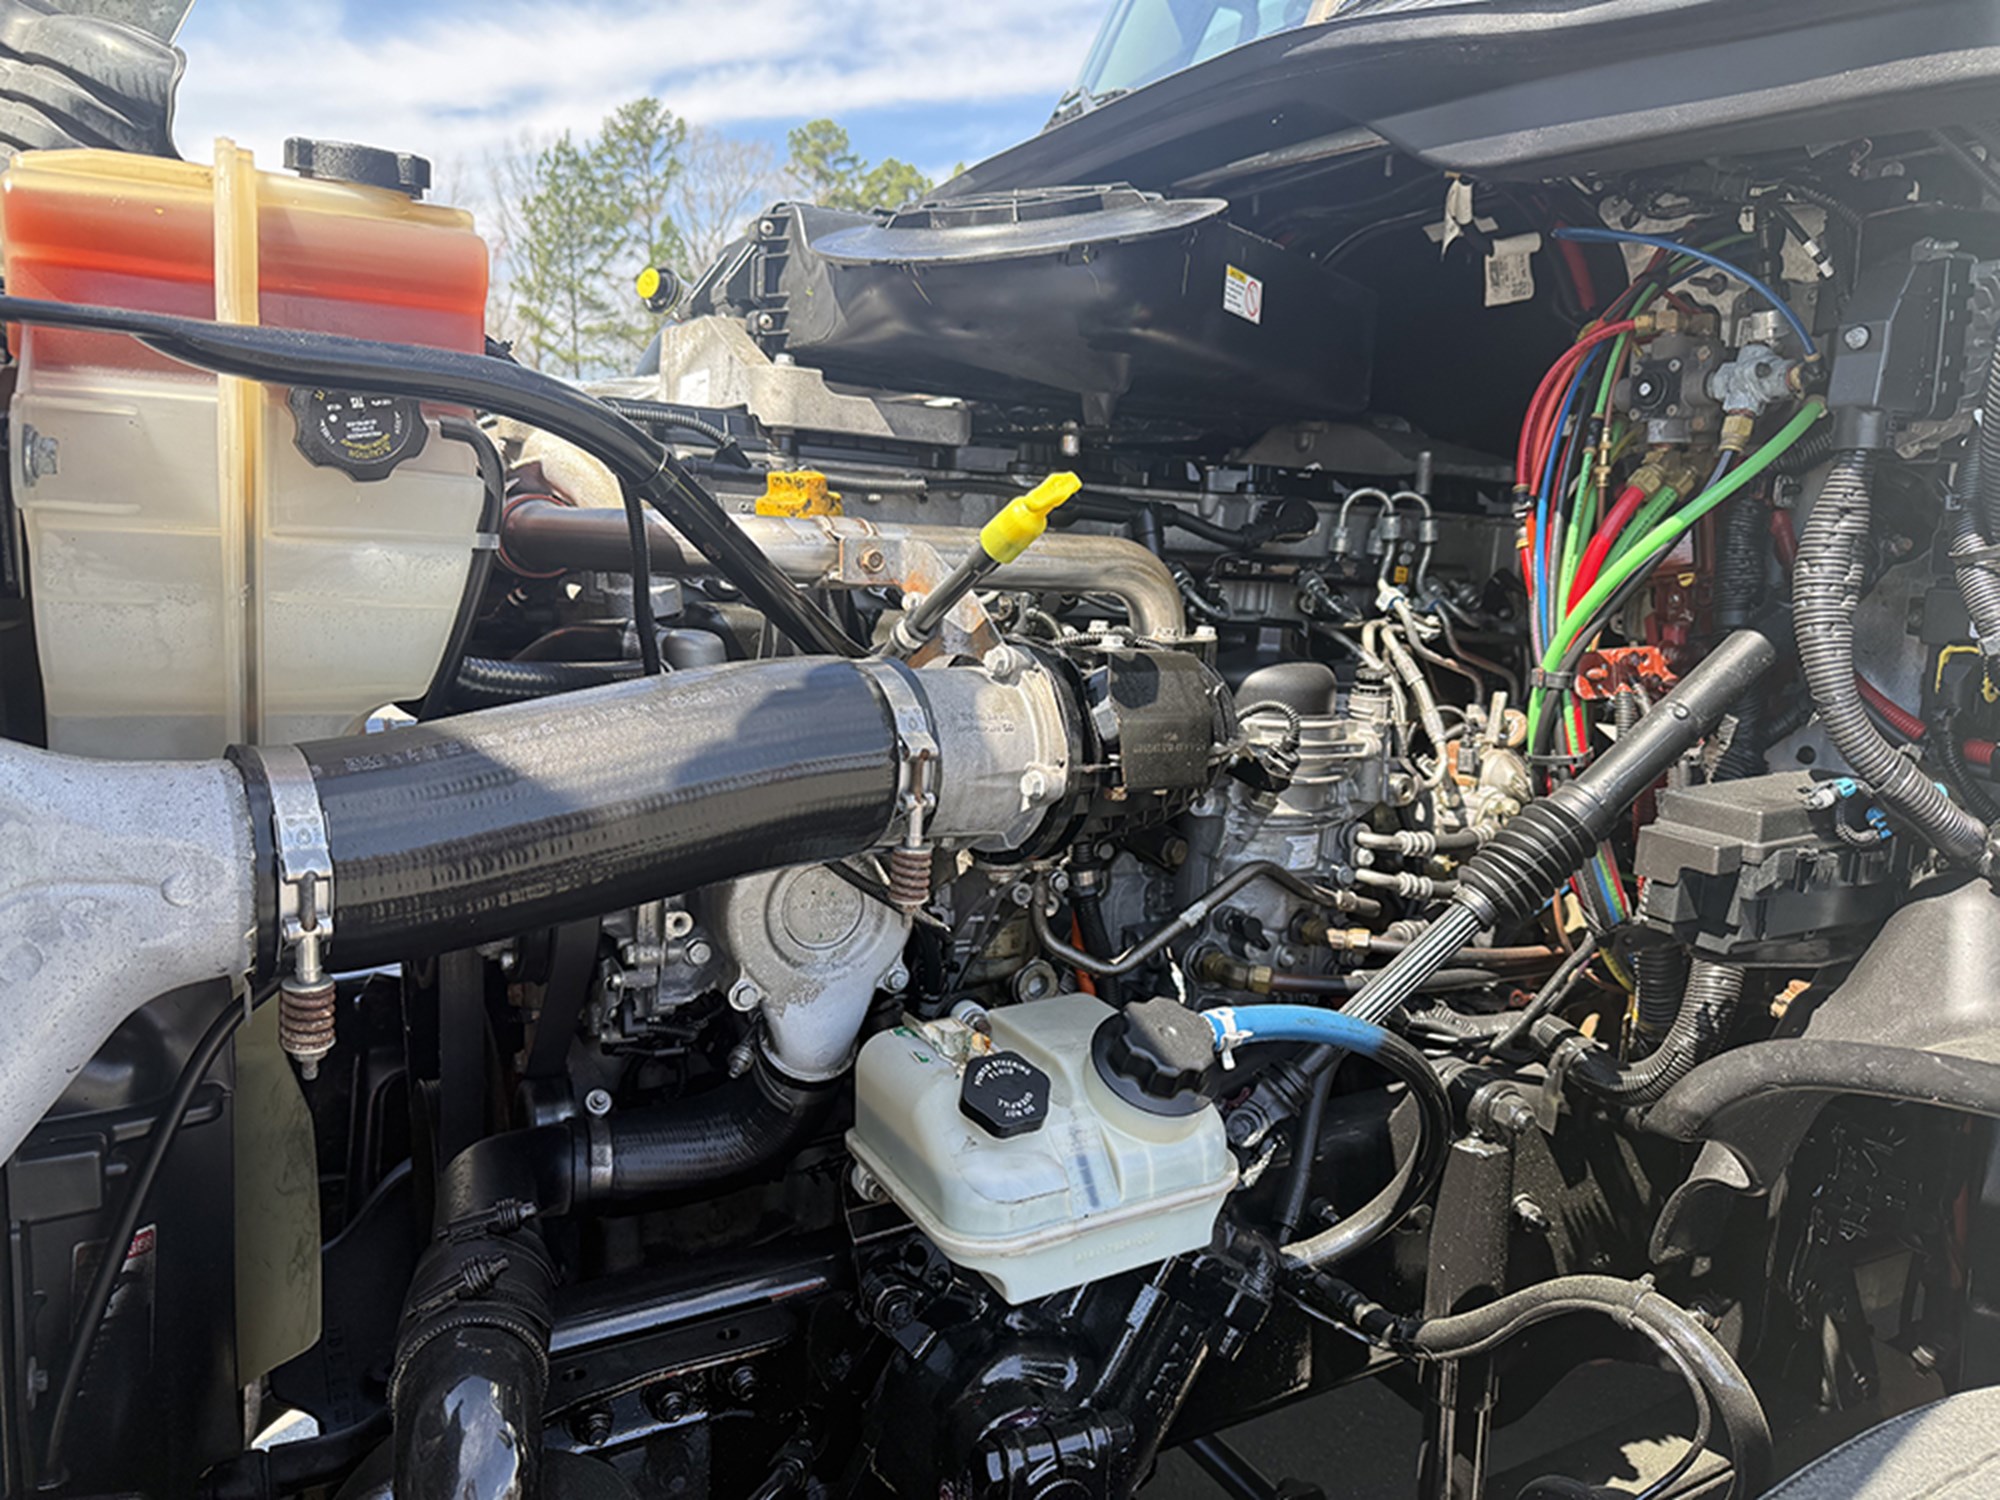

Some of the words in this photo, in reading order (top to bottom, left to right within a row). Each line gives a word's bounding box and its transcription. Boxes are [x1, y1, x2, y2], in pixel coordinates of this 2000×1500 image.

[974, 1063, 991, 1087] POWER
[992, 1060, 1031, 1075] STEERING
[988, 1068, 1014, 1079] FLUID
[998, 1092, 1033, 1108] OVERFILL
[1005, 1110, 1022, 1118] NOT
